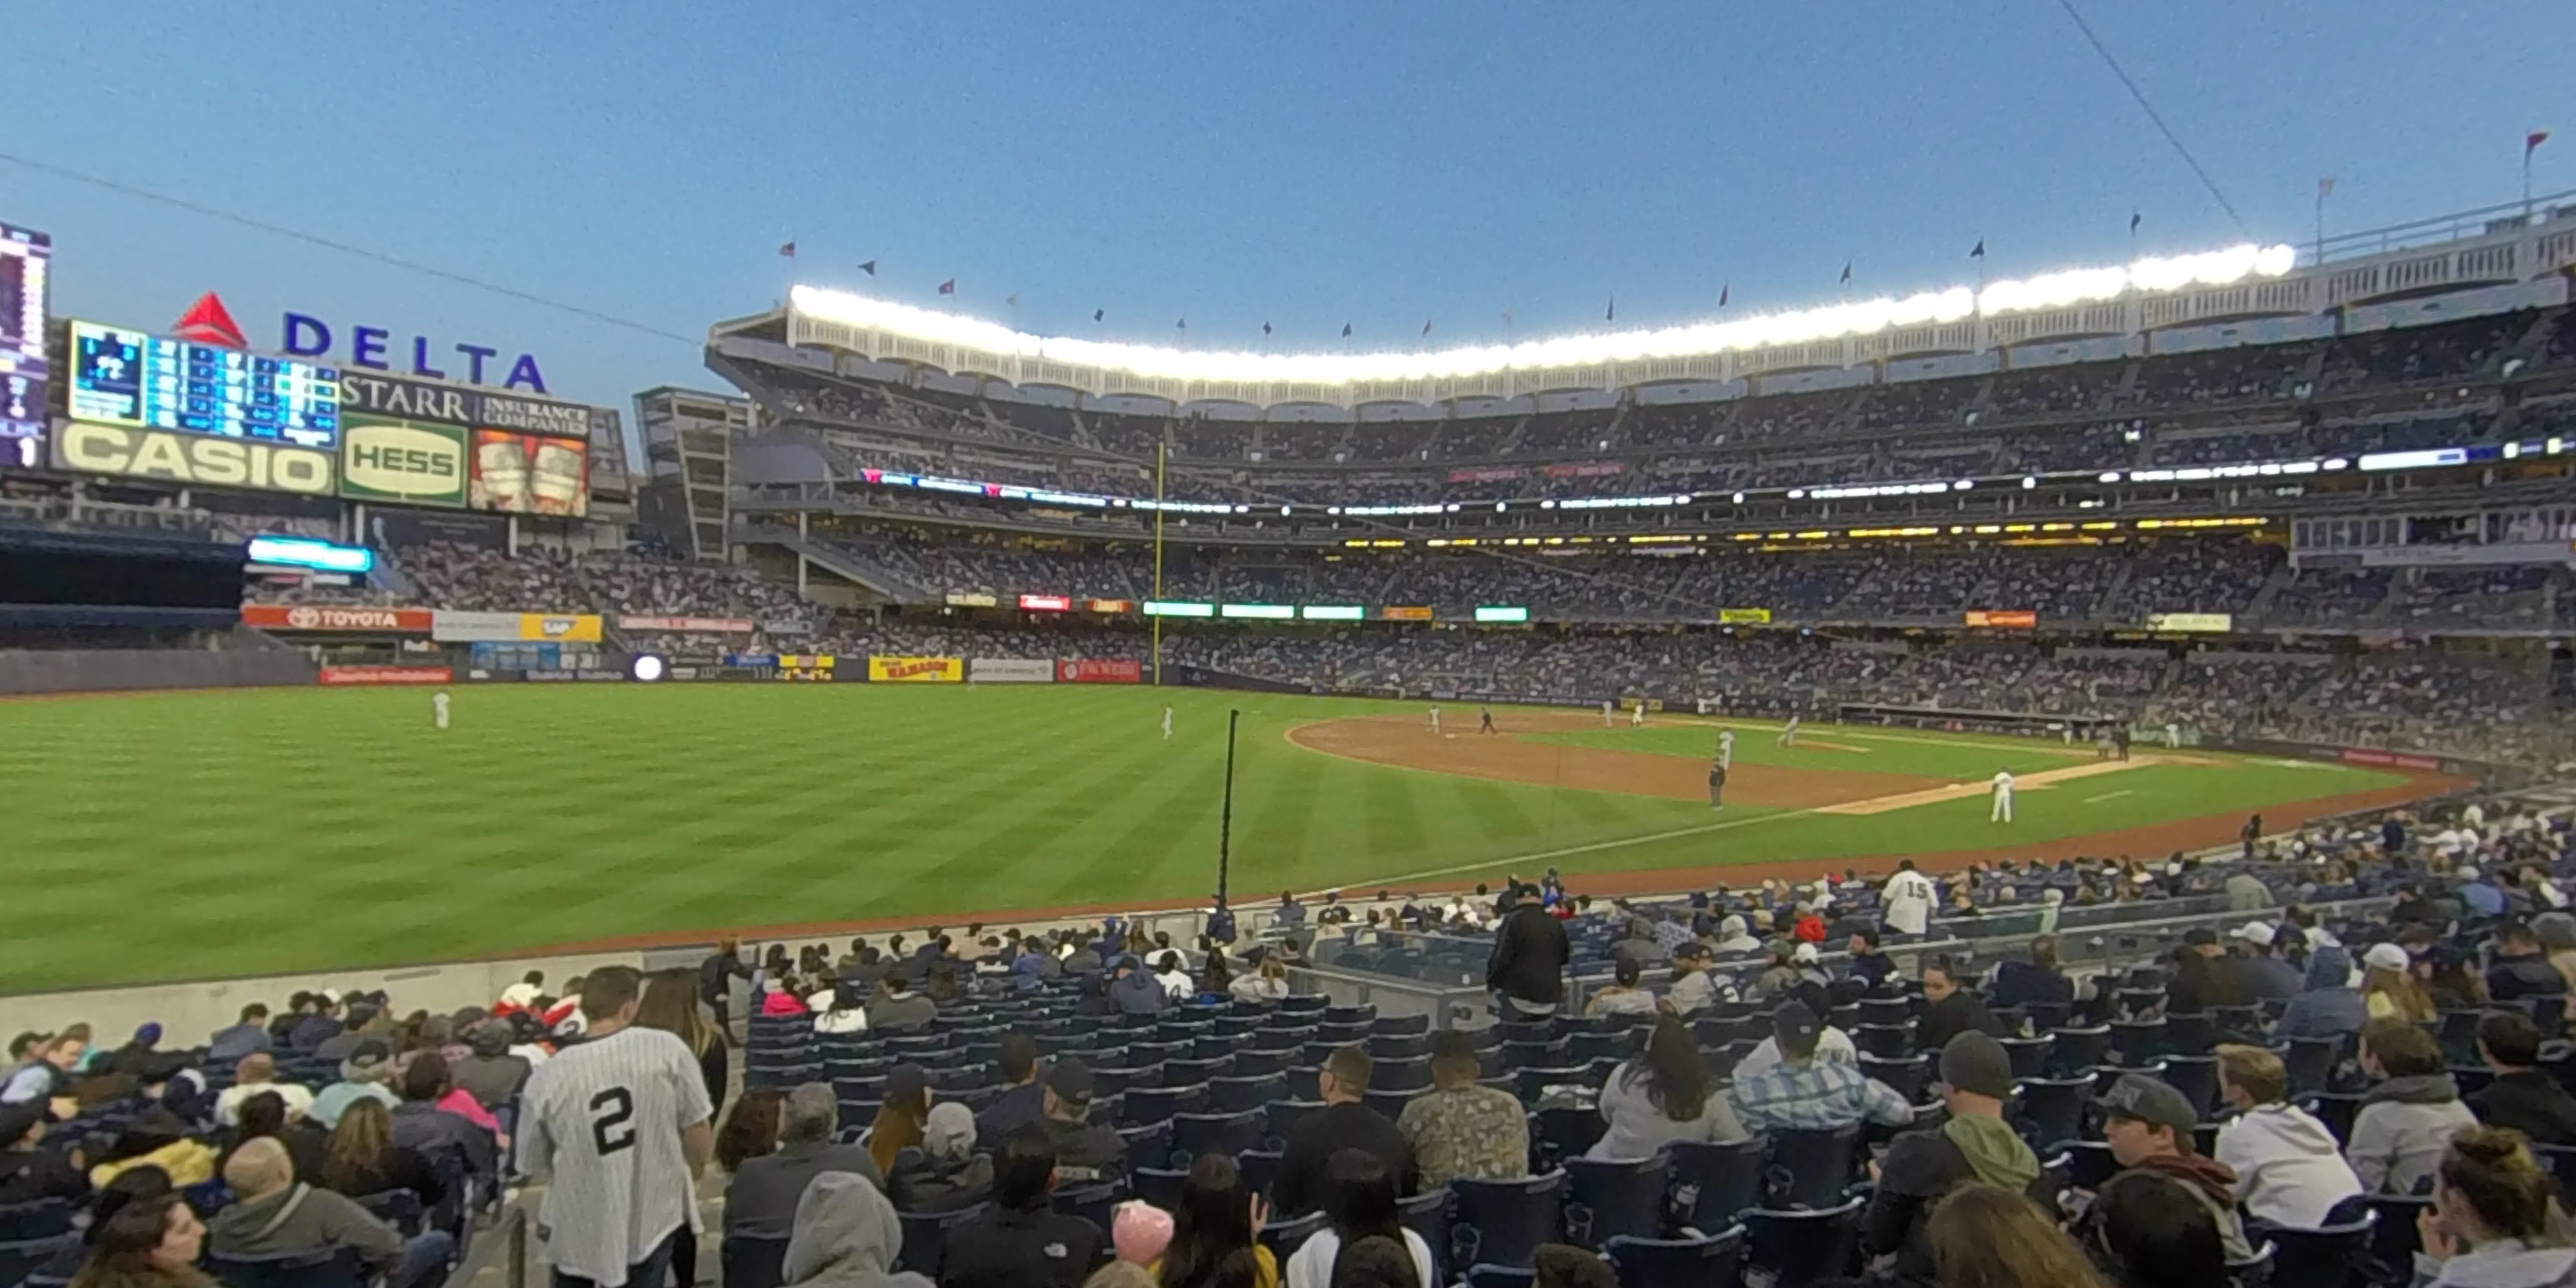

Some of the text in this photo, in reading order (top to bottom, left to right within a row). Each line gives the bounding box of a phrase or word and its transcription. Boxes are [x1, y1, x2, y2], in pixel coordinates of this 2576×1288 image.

[283, 312, 548, 394] DELTA
[341, 376, 470, 422] STARR
[484, 397, 589, 420] INSURANCE
[483, 412, 588, 434] COMPANIES
[63, 423, 328, 491] CASIO
[353, 443, 455, 477] HESS
[322, 610, 397, 628] TOYOTA
[543, 622, 570, 635] SAP
[1907, 881, 1928, 899] 15
[590, 1086, 636, 1156] 2
